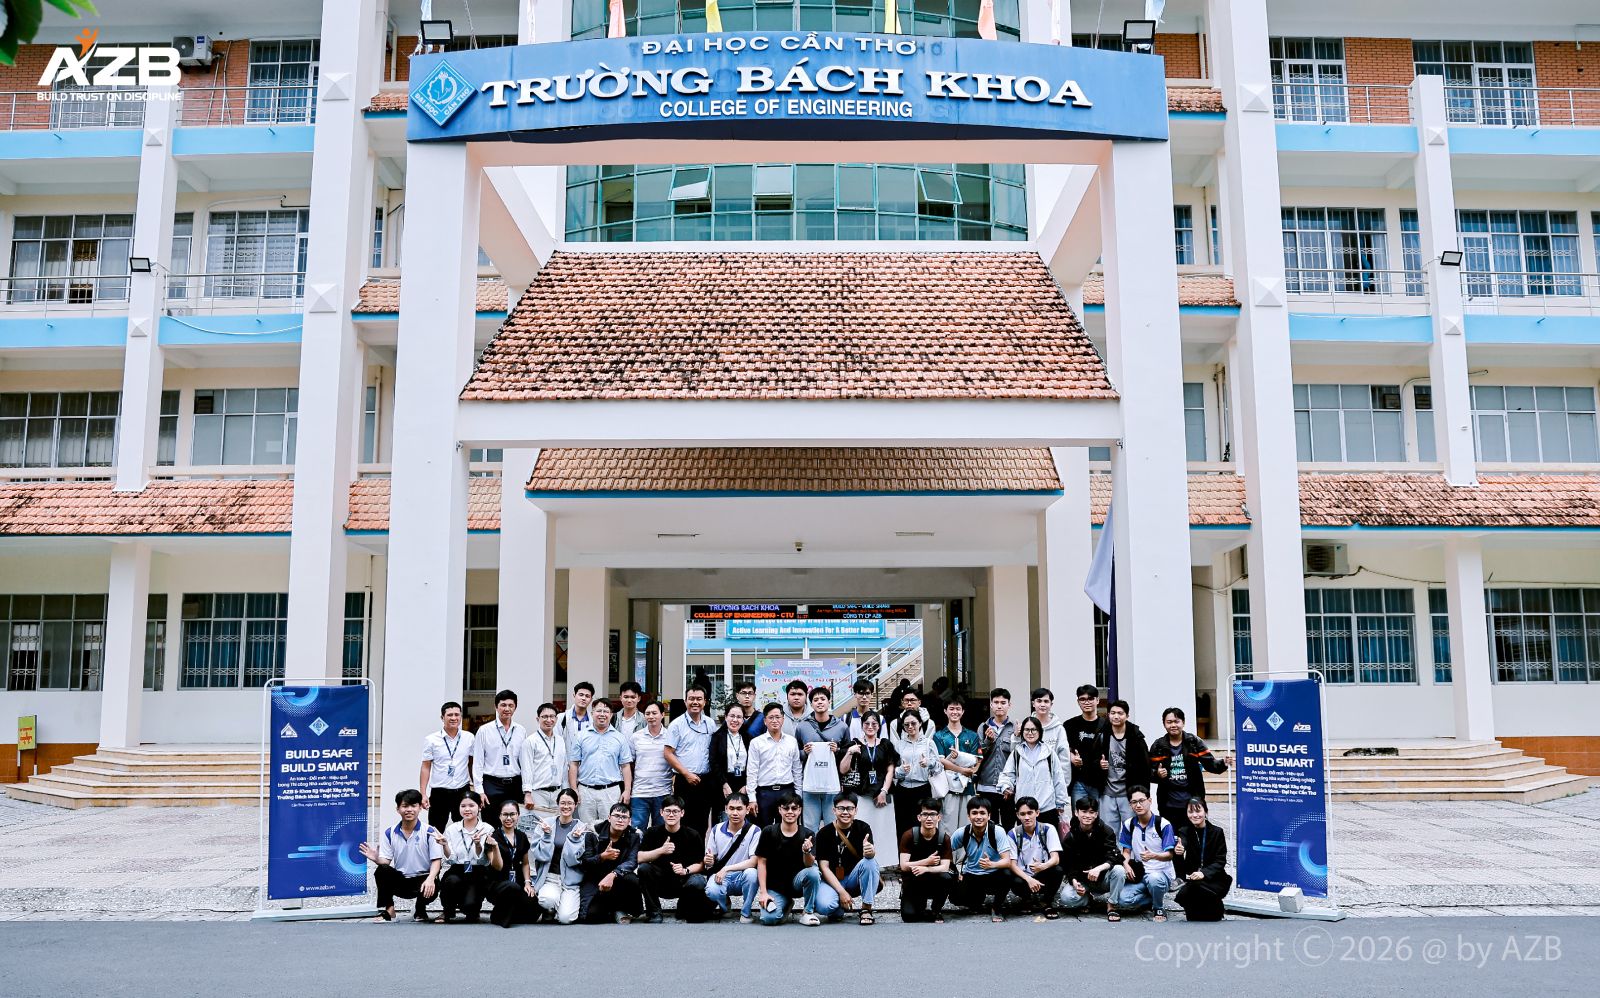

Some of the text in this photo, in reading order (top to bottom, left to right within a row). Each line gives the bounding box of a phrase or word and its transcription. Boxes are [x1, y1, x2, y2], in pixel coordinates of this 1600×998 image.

[642, 32, 917, 56] ĐẠI HỌC CẦN THƠ
[481, 57, 1092, 108] TRƯỜNG BÁCH KHOA
[660, 98, 913, 118] COLLEGE OF ENGINEERING
[286, 749, 352, 759] BUILD SAFE
[1247, 744, 1308, 754] BUILD SAFE
[281, 762, 359, 772] BUILD SMART
[1244, 757, 1314, 768] BUILD SMART
